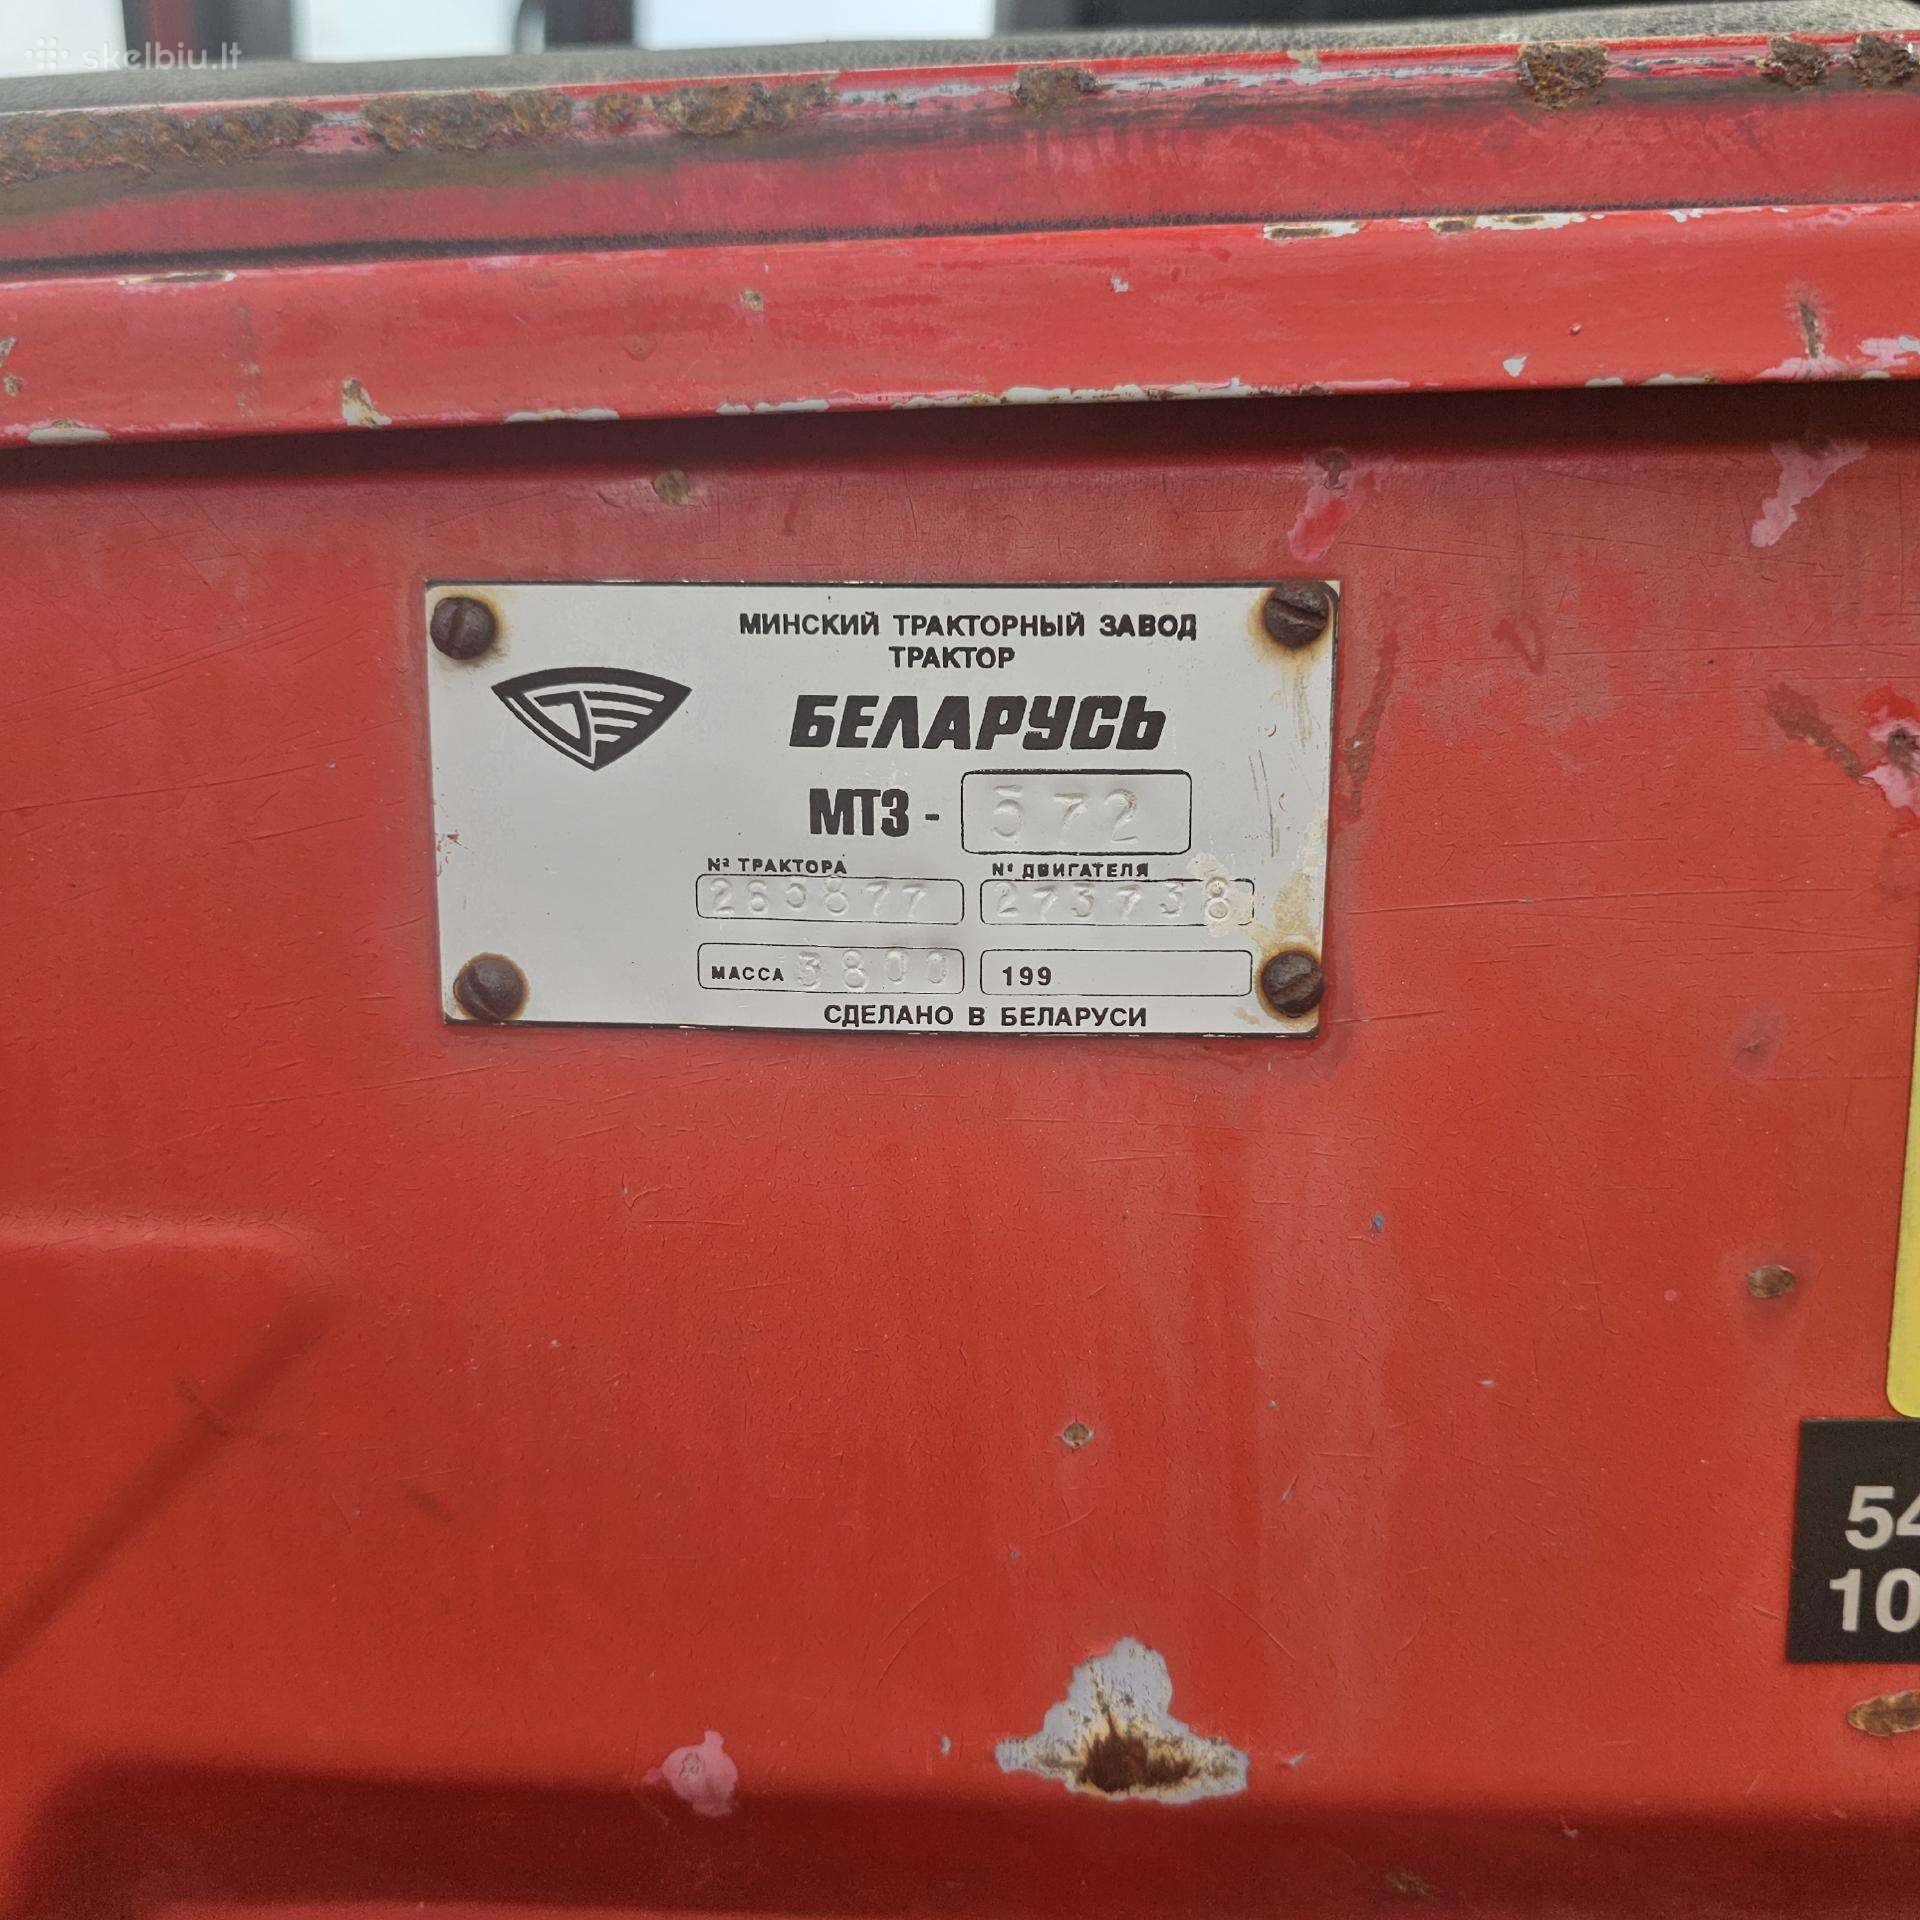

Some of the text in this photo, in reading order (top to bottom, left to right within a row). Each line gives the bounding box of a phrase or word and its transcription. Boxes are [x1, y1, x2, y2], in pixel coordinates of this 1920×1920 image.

[740, 611, 1198, 641] МИНСКИЙ ТРАКТОРНЫЙ ЗАВОД
[889, 645, 1016, 669] ТРАКТОР
[789, 694, 1167, 750] БЕЛАРУСЬ
[993, 783, 1139, 843] 572
[738, 857, 848, 875] ТРАКТОРА
[1022, 862, 1150, 880] ДВИГАТЕЛЯ
[711, 965, 784, 982] МАССА
[1002, 966, 1052, 986] 199
[824, 1004, 1147, 1028] СДЕЛАНО В БЕЛАРУСИ
